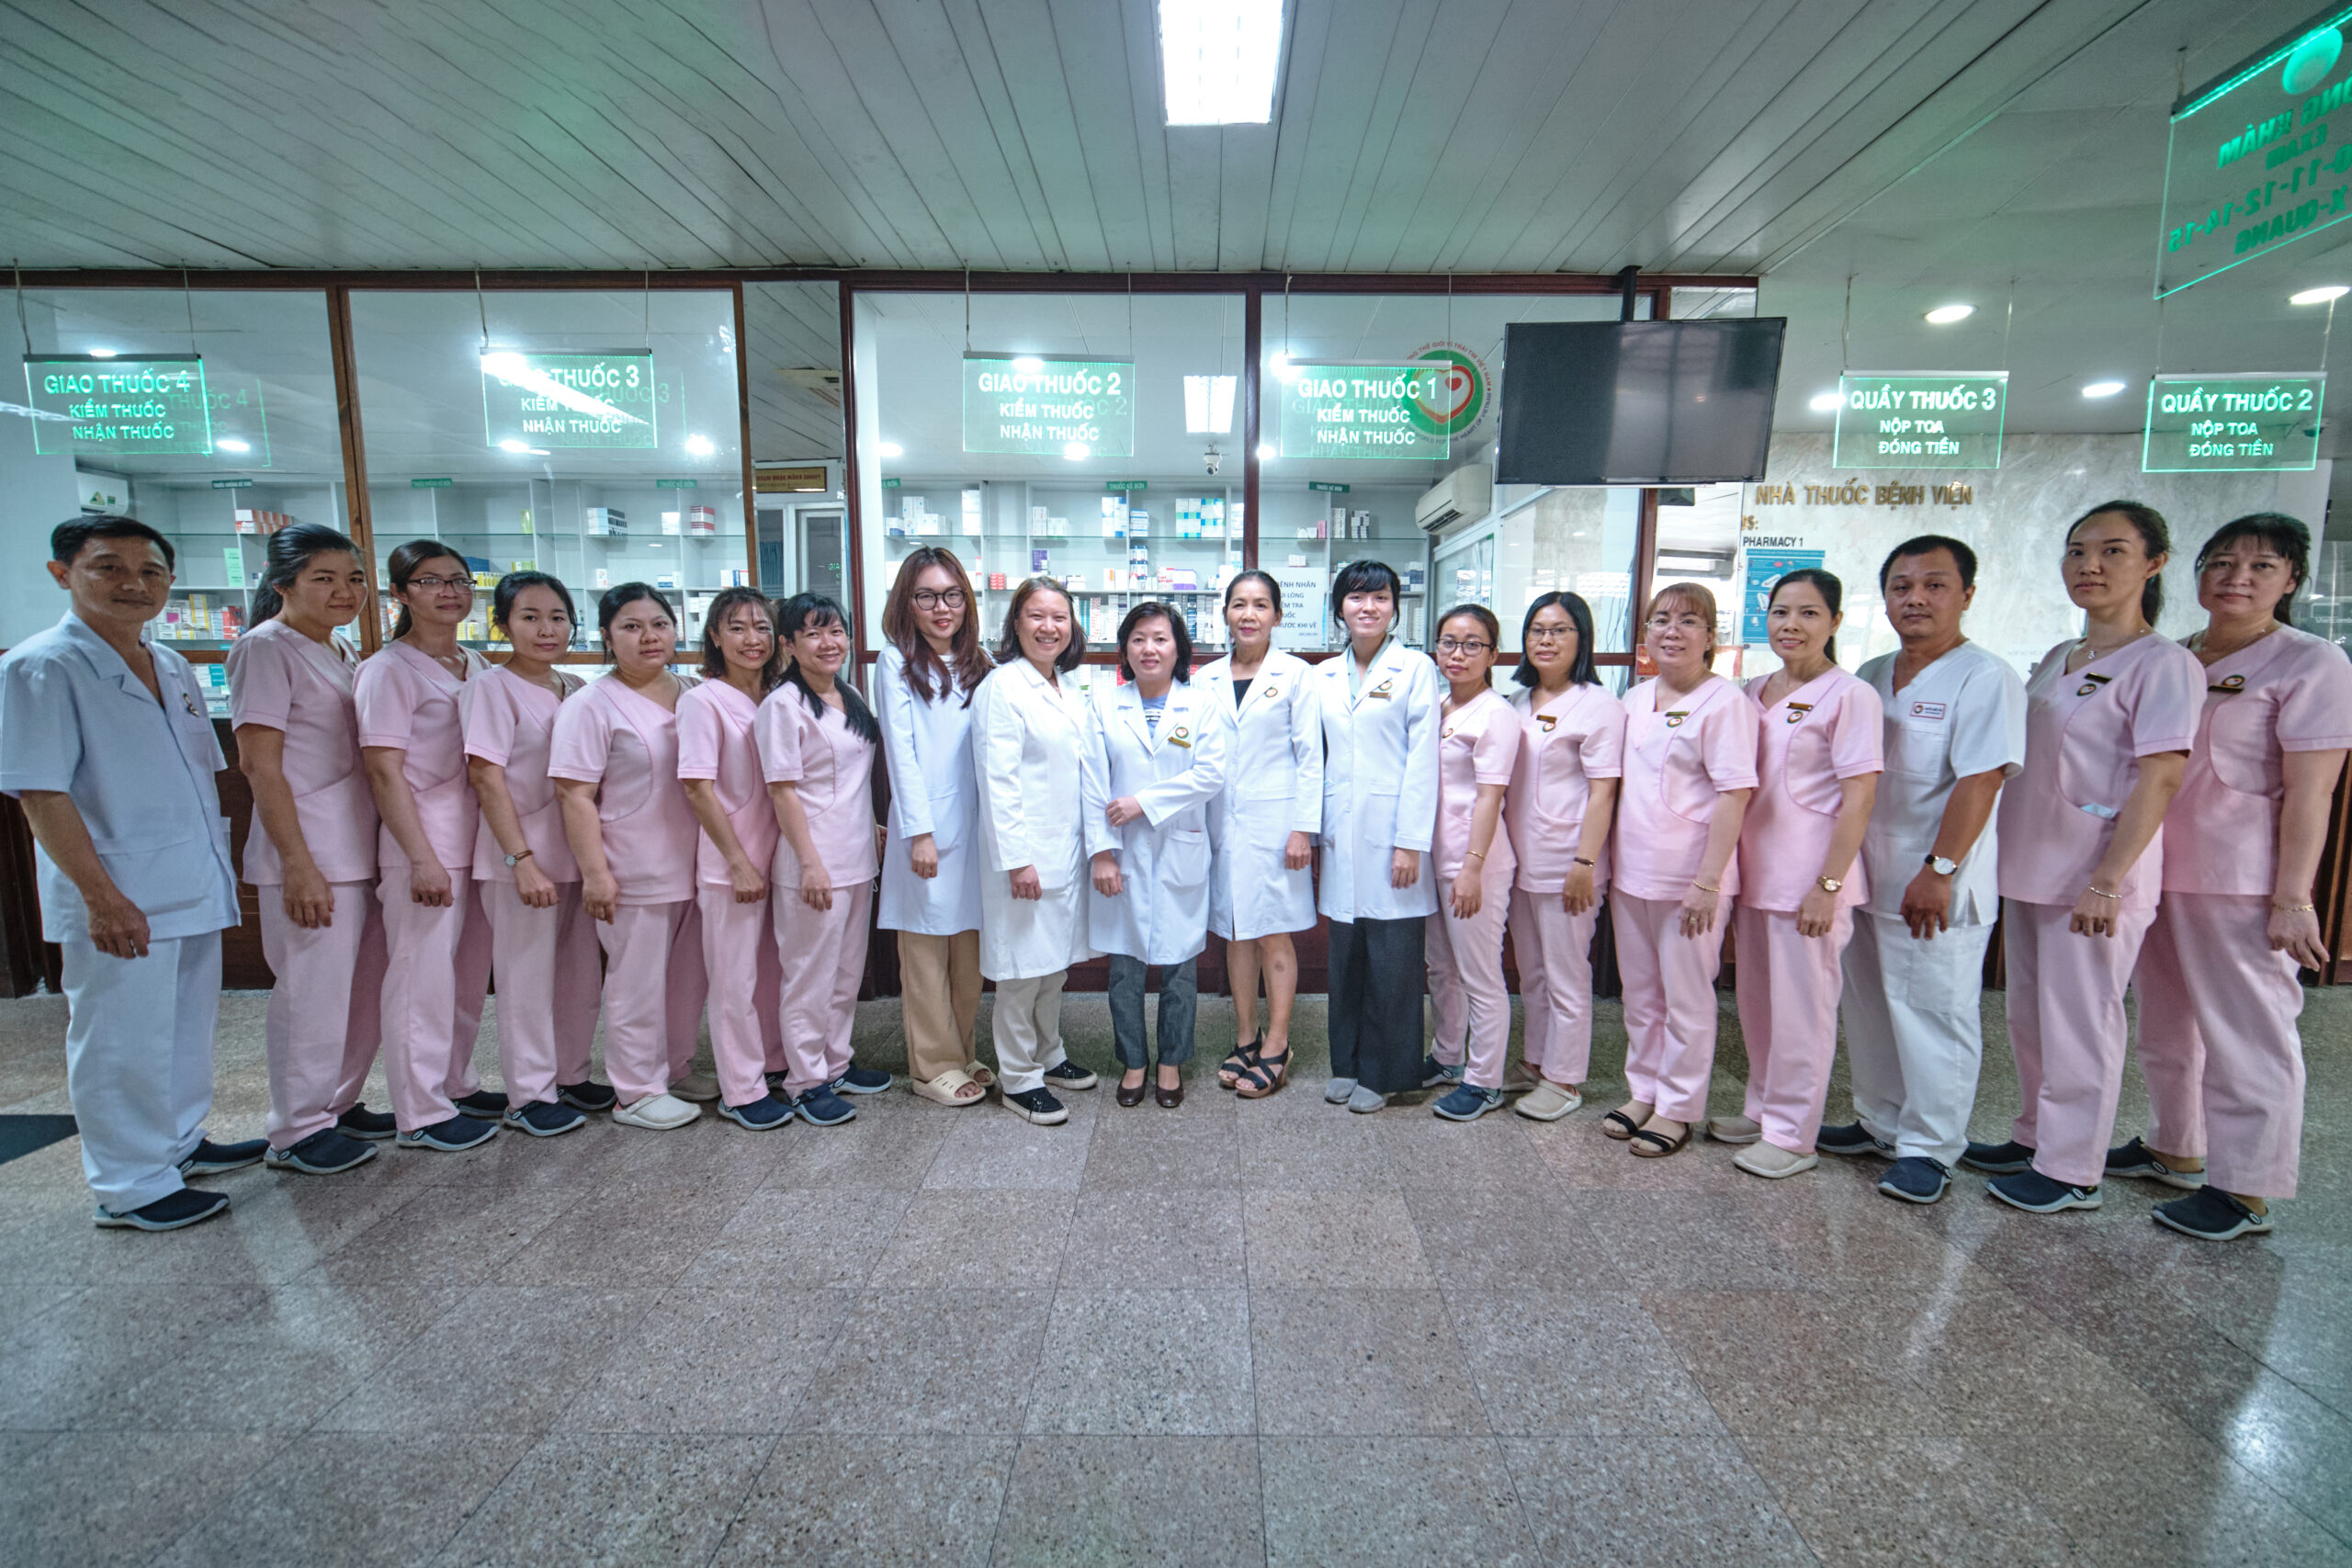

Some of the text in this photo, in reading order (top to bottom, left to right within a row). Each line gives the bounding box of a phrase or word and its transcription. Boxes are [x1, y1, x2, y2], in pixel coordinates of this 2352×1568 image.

[44, 368, 190, 393] GIAO THUỐC 4
[626, 365, 640, 388] 3
[978, 368, 1122, 396] GIAO THUỐC 2
[1298, 374, 1437, 400] GIAO THUỐC 1
[1850, 384, 1996, 411] QUẦY THUỐC 3
[2161, 386, 2313, 412] QUẦY THUỐC 2
[70, 399, 166, 418] KIỂM THUỐC
[1000, 397, 1094, 420] KIỂM THUỐC
[1317, 403, 1411, 423] KIỂM THUỐC
[73, 421, 175, 441] NHẬN THUỐC
[523, 416, 565, 434] NHẬN
[1000, 423, 1100, 441] NHẬN THUỐC
[1880, 417, 1944, 435] NỘP TOA
[2191, 420, 2258, 438] NỘP TOA
[1317, 427, 1416, 446] NHẬN THUỐC
[1878, 436, 1960, 455] ĐÓNG TIỀN
[2189, 438, 2274, 457] ĐÓNG TIỀN
[1756, 478, 1974, 510] NHÀ THUỐC BỆNH VIỆN
[1743, 536, 1804, 547] PHARMACY 1
